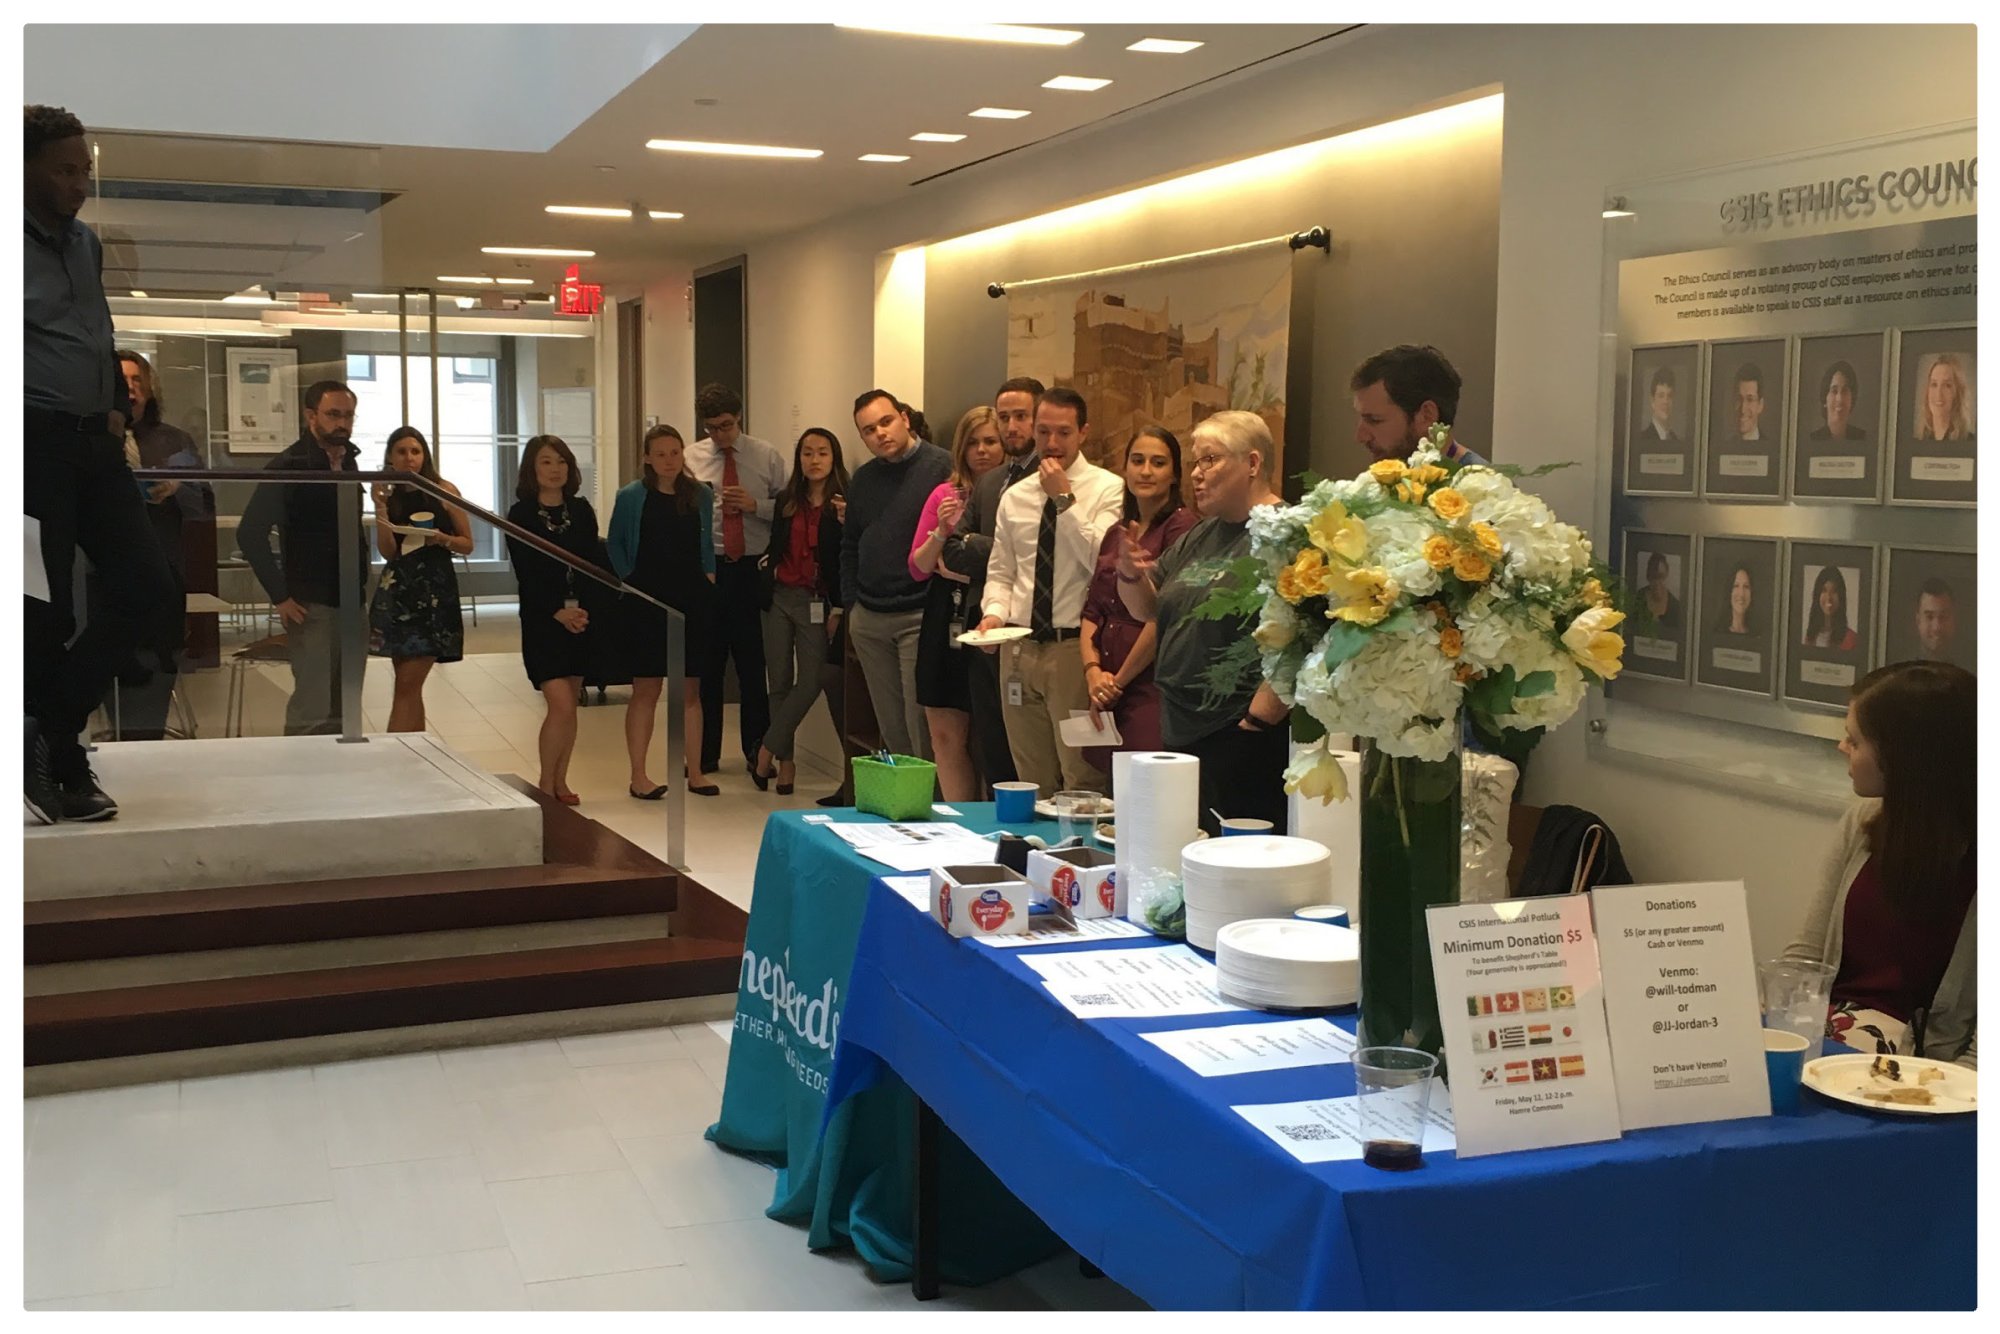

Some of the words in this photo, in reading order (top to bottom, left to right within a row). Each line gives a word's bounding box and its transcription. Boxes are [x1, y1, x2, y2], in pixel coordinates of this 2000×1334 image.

[1720, 191, 1769, 224] CSIS
[1777, 174, 1870, 215] ETHICS
[1663, 276, 1677, 287] The
[1679, 274, 1700, 286] Ethics
[1702, 270, 1731, 282] Council
[1732, 270, 1757, 280] serves
[1758, 268, 1768, 277] as
[1769, 267, 1780, 276] an
[1782, 261, 1818, 273] advisory
[1819, 258, 1841, 271] body
[1842, 258, 1855, 268] on
[1857, 253, 1892, 266] matters
[1894, 250, 1904, 261] of
[1906, 248, 1934, 260] ethics
[1937, 245, 1956, 256] and
[1654, 294, 1668, 305] The
[1670, 291, 1697, 304] Council
[1699, 290, 1705, 300] is
[1706, 289, 1728, 300] made
[1729, 289, 1739, 300] up
[1742, 286, 1750, 296] of
[1751, 286, 1756, 296] a
[1758, 282, 1790, 294] rotating
[1792, 280, 1817, 294] group
[1819, 277, 1829, 288] of
[1852, 270, 1900, 286] employees
[1904, 268, 1924, 280] who
[1926, 266, 1952, 278] serve
[1955, 264, 1970, 275] for
[1677, 307, 1712, 320] members
[1713, 306, 1719, 316] is
[1720, 302, 1754, 315] available
[1756, 302, 1764, 312] to
[1766, 300, 1790, 313] speak
[1792, 300, 1800, 310] to
[1802, 296, 1822, 308] CSIS
[1824, 294, 1842, 307] staff
[1844, 295, 1854, 304] as
[1856, 295, 1861, 304] a
[1864, 290, 1902, 302] resource
[1906, 290, 1918, 300] on
[1920, 286, 1950, 298] ethics
[1952, 283, 1972, 296] and
[976, 905, 1004, 915] Everyday
[1646, 899, 1696, 911] Donations
[1458, 919, 1476, 929] CSIS
[1531, 912, 1560, 922] Potluck
[1624, 928, 1634, 938] $5
[1635, 928, 1646, 938] (or
[1648, 928, 1662, 936] any
[1664, 926, 1690, 936] greater
[1692, 922, 1724, 933] amount)
[1443, 938, 1504, 954] Minimum
[1507, 932, 1564, 948] Donation
[1566, 929, 1582, 944] $5
[1648, 940, 1666, 948] Cash
[1482, 955, 1504, 964] benefit
[1505, 952, 1540, 963] Shepherd's
[1466, 968, 1484, 978] (Your
[1484, 964, 1518, 976] generosity
[1519, 964, 1524, 972] is
[1659, 967, 1699, 978] Venmo:
[1646, 982, 1717, 998] @will-todman
[1678, 1004, 1689, 1012] or
[1652, 1016, 1718, 1034] @JJ-Jordan-3
[1653, 1064, 1675, 1074] Don't
[1676, 1063, 1694, 1072] have
[1696, 1058, 1728, 1070] Venmo?
[1495, 1098, 1517, 1106] Friday,
[1518, 1096, 1532, 1104] May
[1560, 1091, 1574, 1099] p.m.
[1532, 1104, 1564, 1112] Commons
